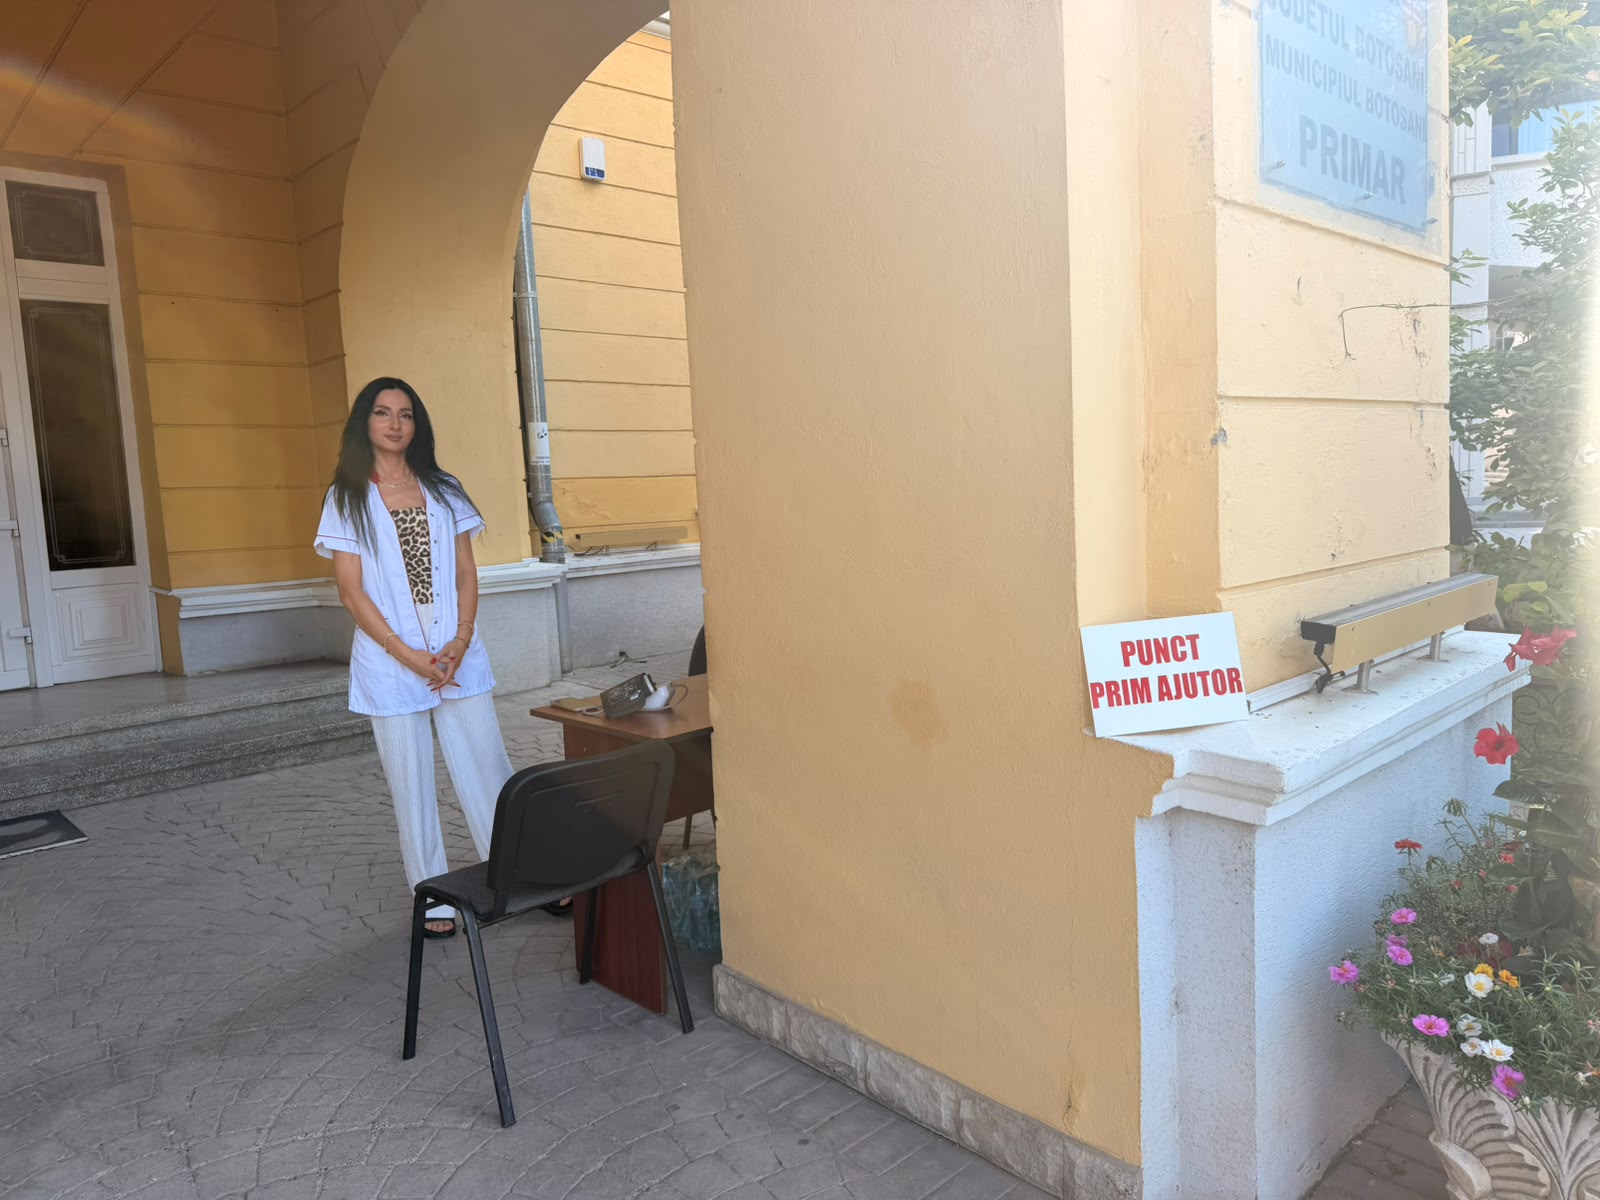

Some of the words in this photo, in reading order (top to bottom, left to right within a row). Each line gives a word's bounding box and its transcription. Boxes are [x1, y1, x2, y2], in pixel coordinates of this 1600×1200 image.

[1265, 33, 1361, 109] MUNICIPIUL
[1299, 114, 1406, 205] PRIMAR
[1120, 633, 1200, 667] PUNCT
[1090, 677, 1153, 709] PRIM
[1157, 667, 1244, 702] AJUTOR
